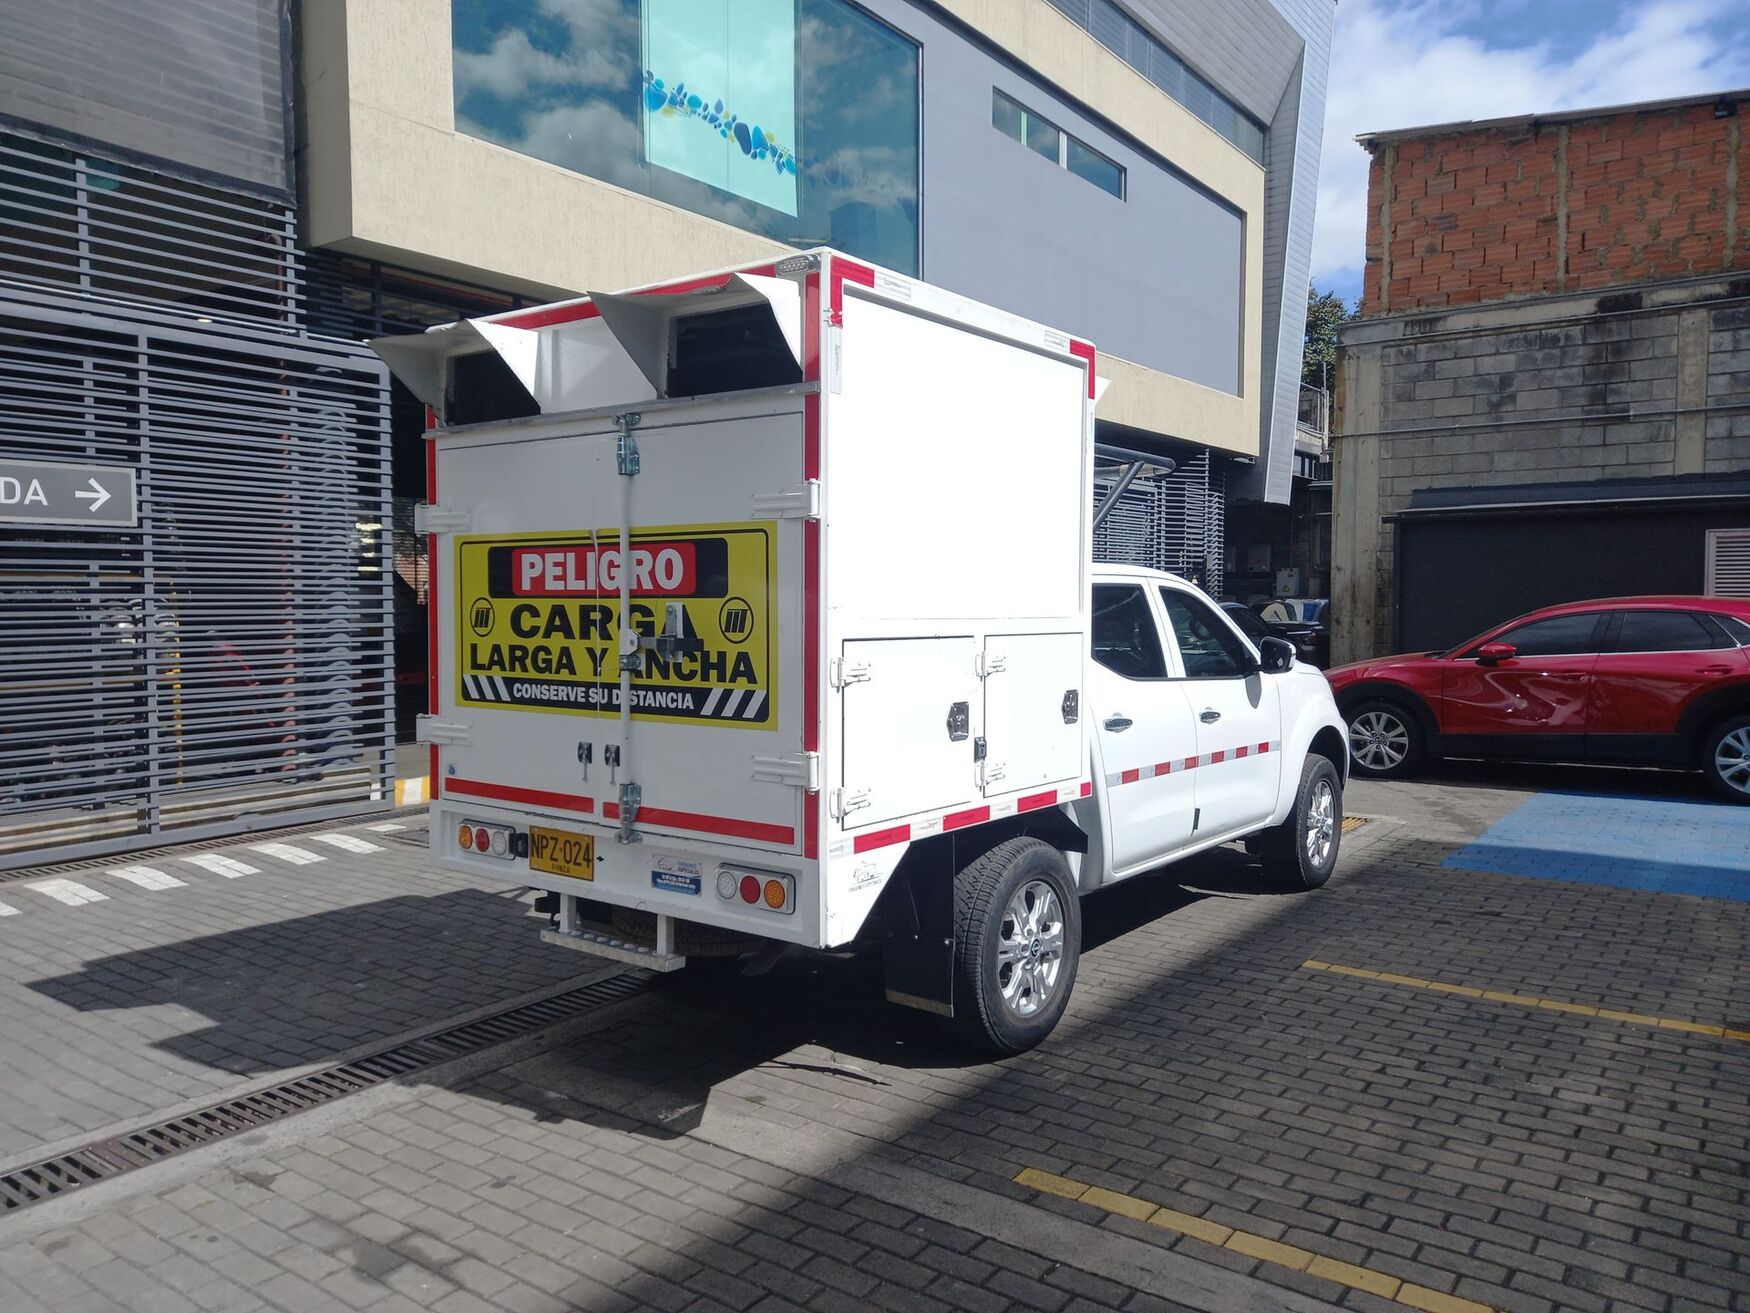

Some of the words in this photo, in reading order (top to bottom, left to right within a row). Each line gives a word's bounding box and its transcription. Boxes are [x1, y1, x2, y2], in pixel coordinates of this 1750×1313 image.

[521, 549, 683, 591] PELIGRO
[470, 643, 576, 675] LARGA
[585, 647, 609, 677] Y
[618, 648, 758, 685] NCHA
[513, 683, 585, 703] CONSERVE
[588, 688, 608, 705] SU
[612, 689, 694, 710] DSTANCIA
